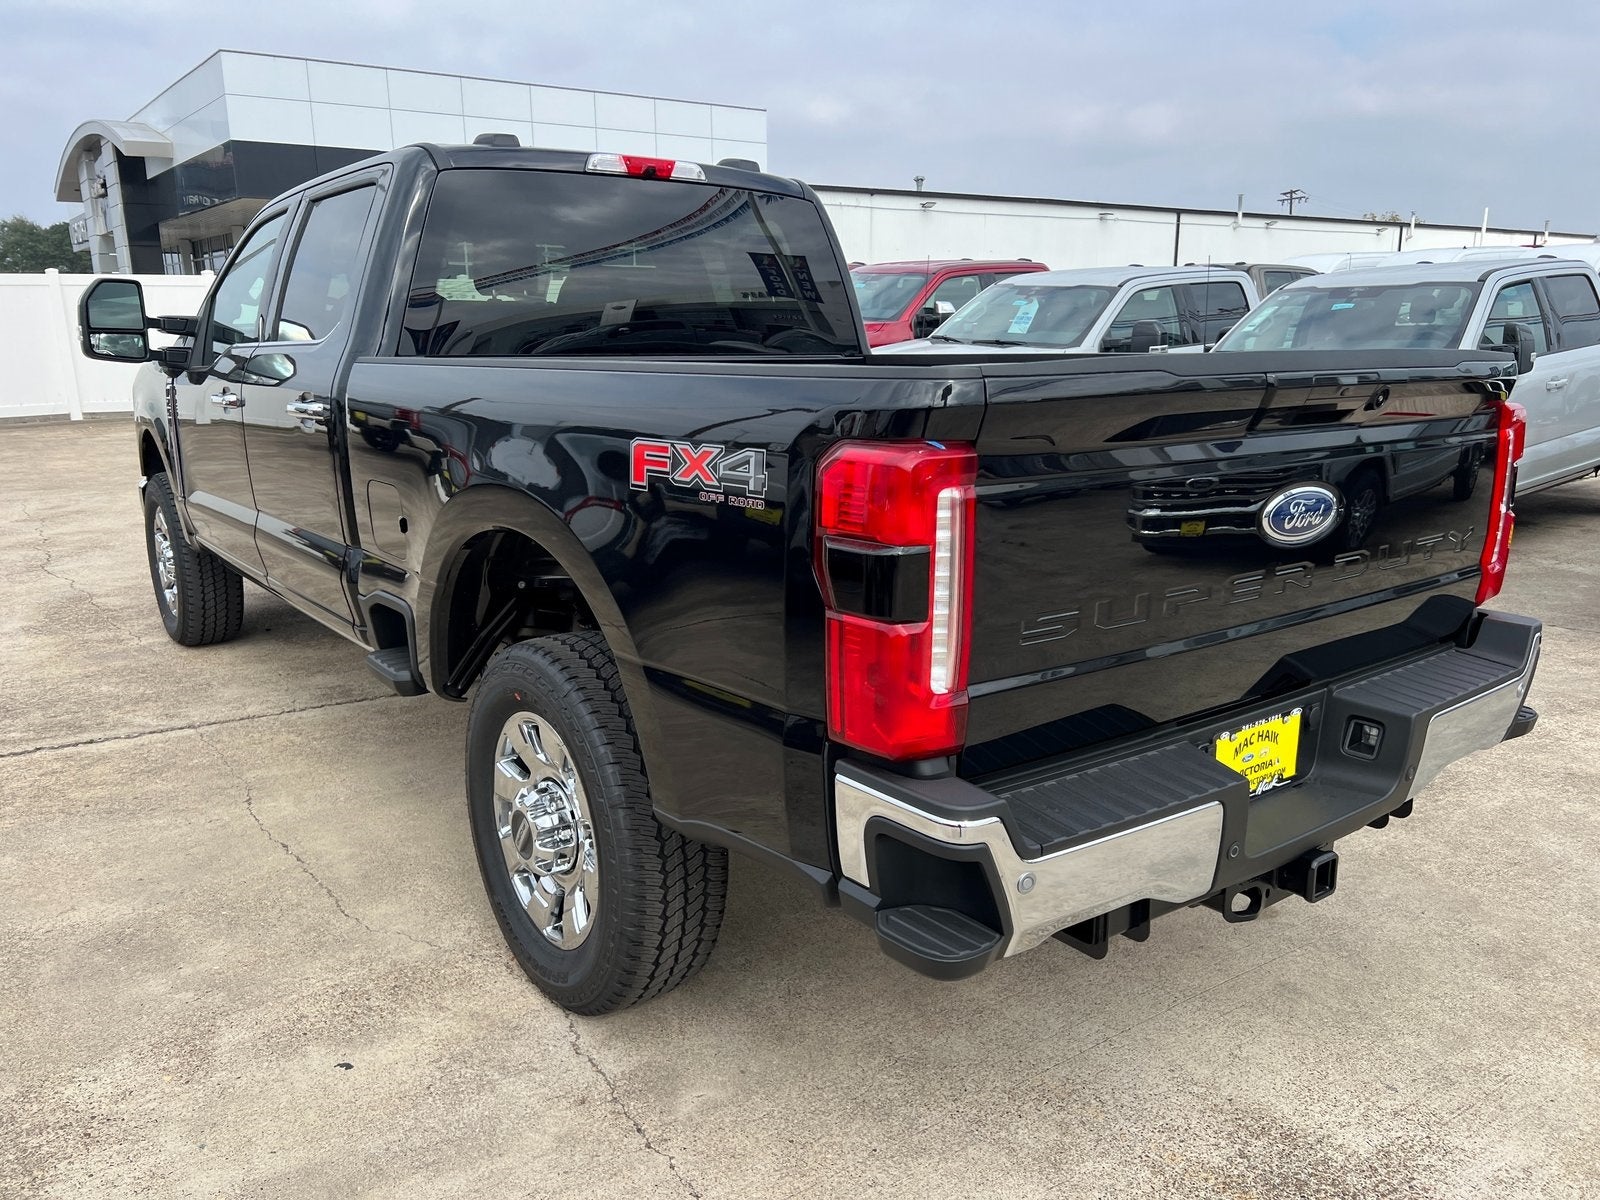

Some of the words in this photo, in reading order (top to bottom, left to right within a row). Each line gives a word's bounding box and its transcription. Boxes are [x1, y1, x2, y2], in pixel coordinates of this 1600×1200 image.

[629, 437, 767, 498] FX4
[699, 491, 725, 503] OFF
[728, 495, 765, 510] ROAD
[1284, 499, 1325, 530] Ford
[1019, 561, 1315, 646] SUPER
[1332, 526, 1474, 582] DUTY
[1233, 732, 1256, 760] MAC
[1257, 729, 1280, 745] HAIK
